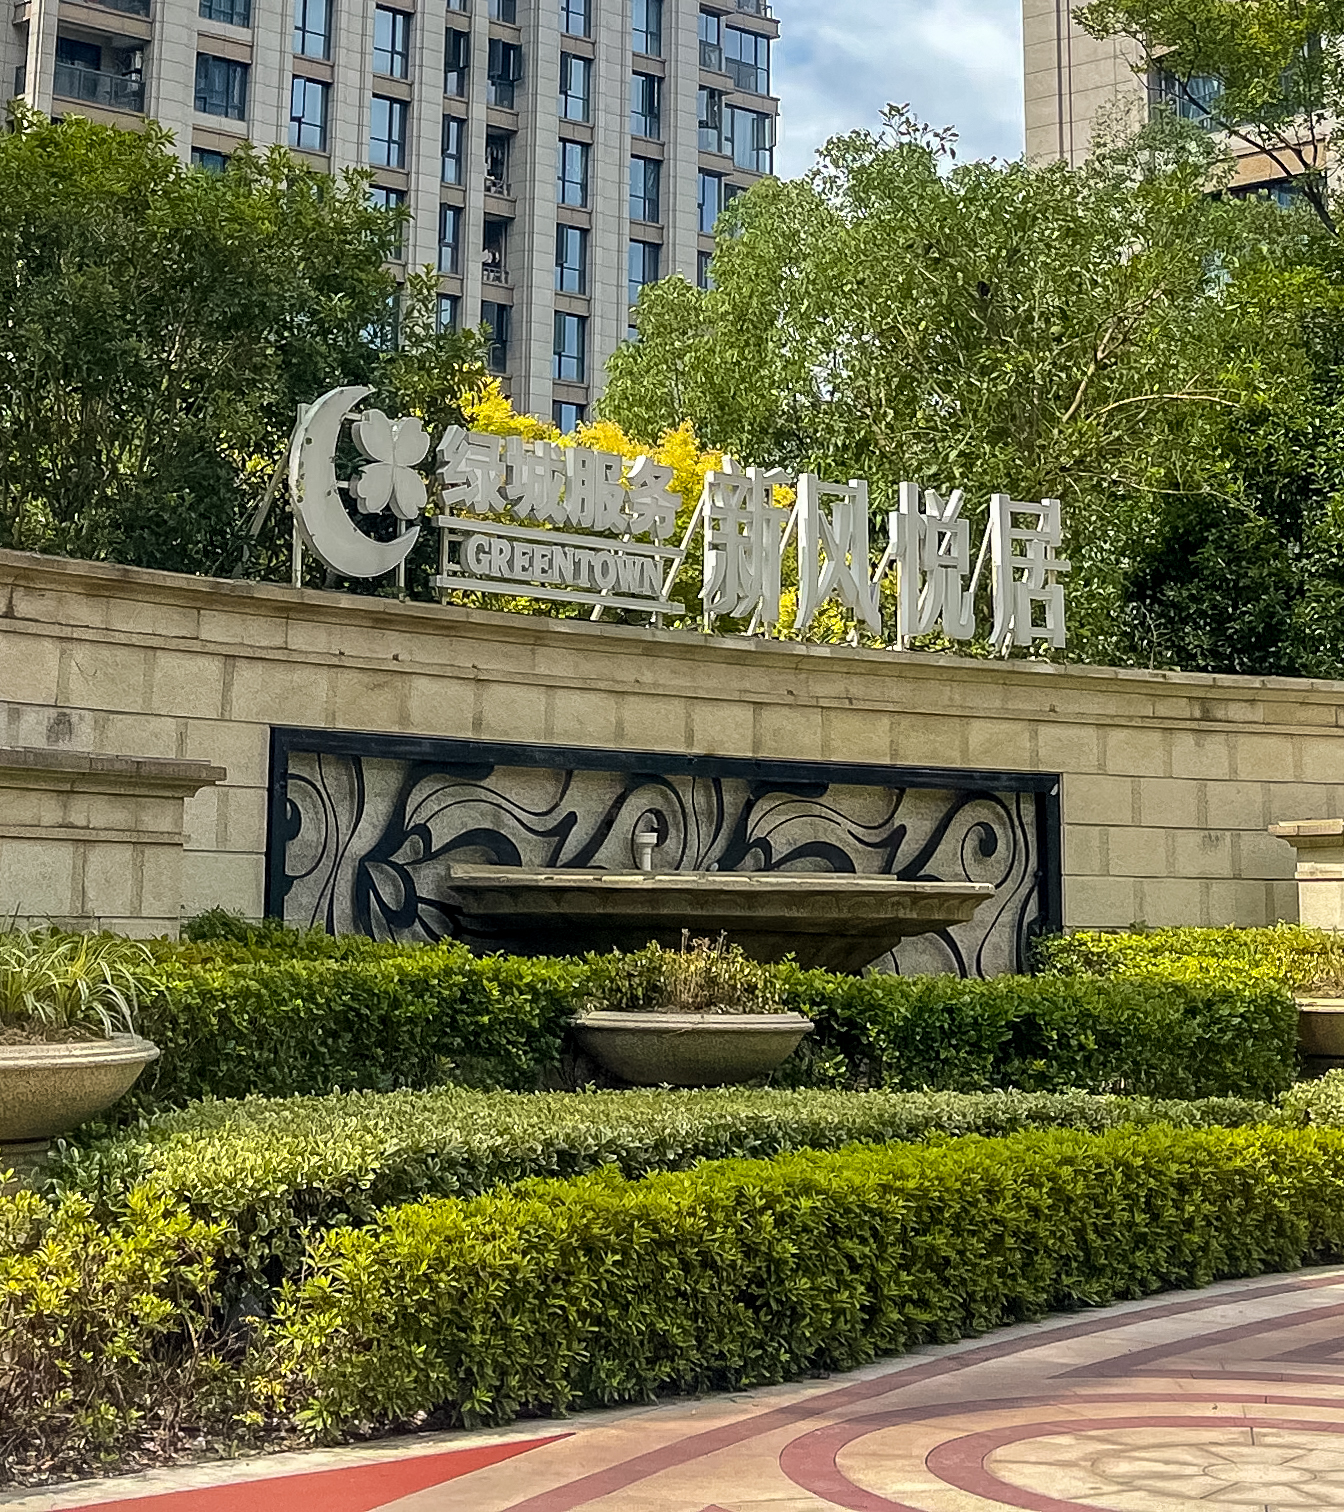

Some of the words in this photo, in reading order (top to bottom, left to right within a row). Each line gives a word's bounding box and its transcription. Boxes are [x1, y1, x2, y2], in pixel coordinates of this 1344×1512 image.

[436, 425, 682, 539] 绿城服务
[461, 534, 664, 596] GREENTOWN
[699, 454, 1071, 649] 新风悦居
